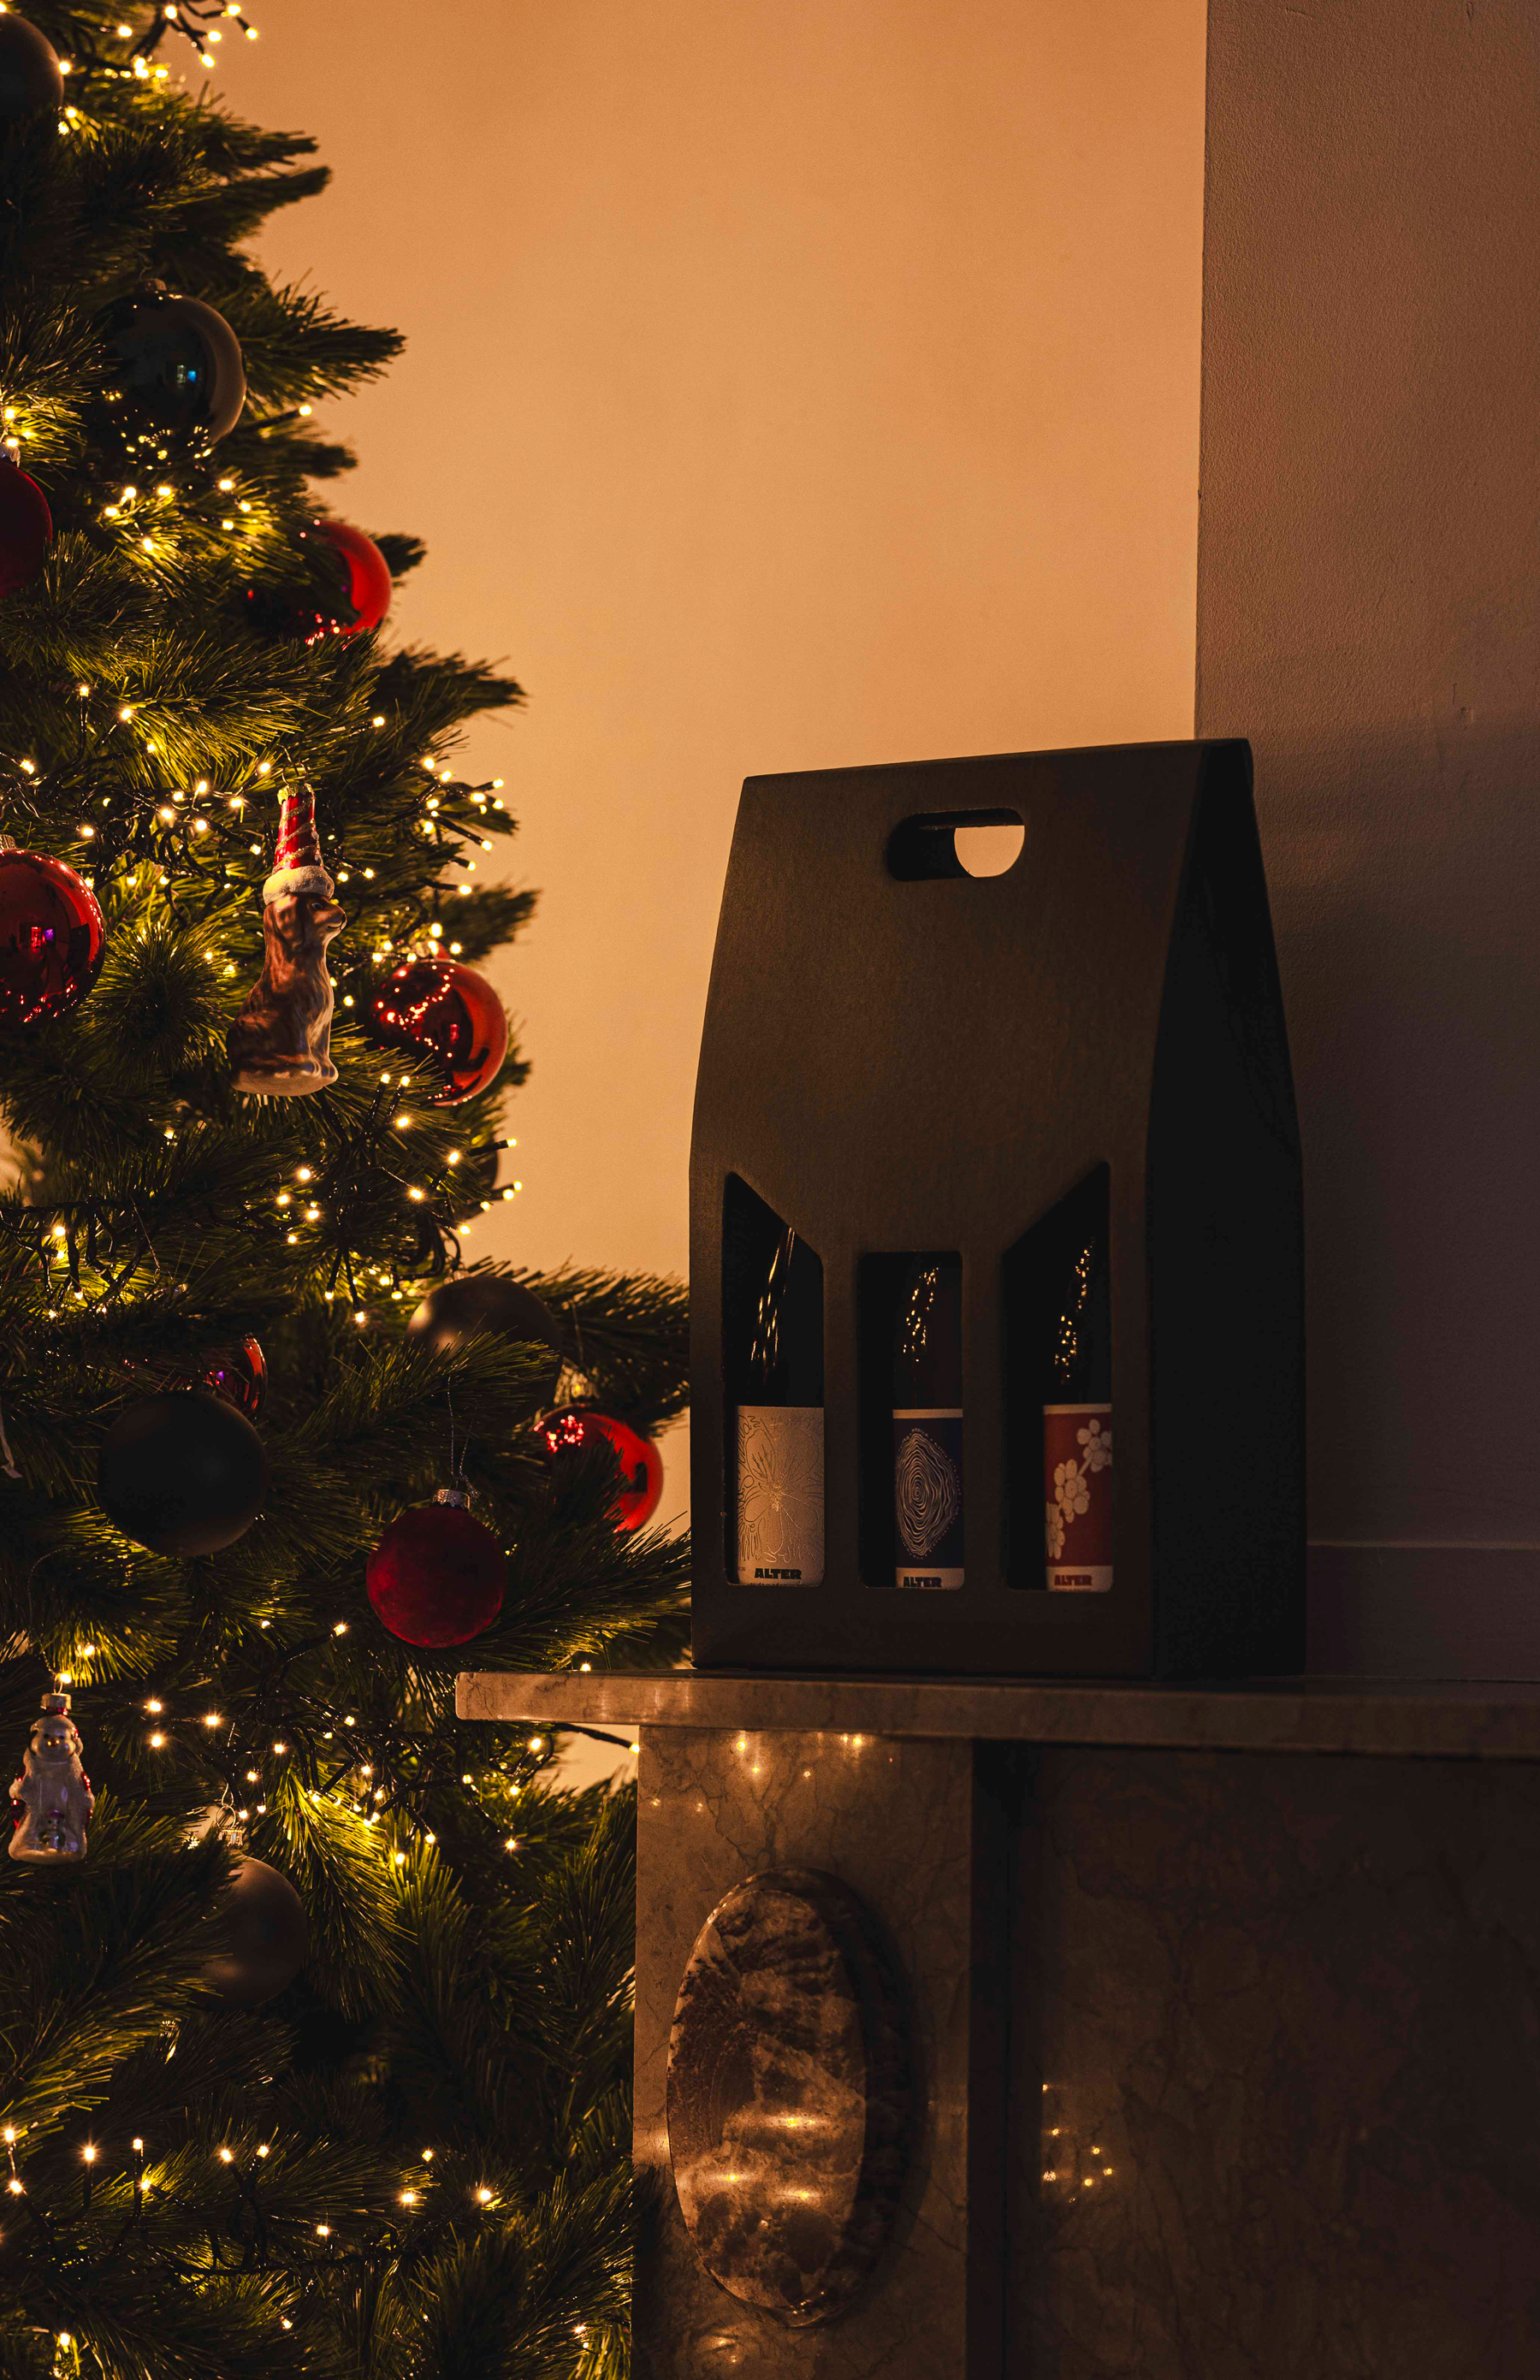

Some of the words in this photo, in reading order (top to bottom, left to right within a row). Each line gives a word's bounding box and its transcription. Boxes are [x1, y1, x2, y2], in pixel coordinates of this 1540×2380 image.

[754, 1567, 803, 1579] ALTER
[903, 1576, 942, 1588] ALTER
[1054, 1574, 1092, 1586] ALTER
